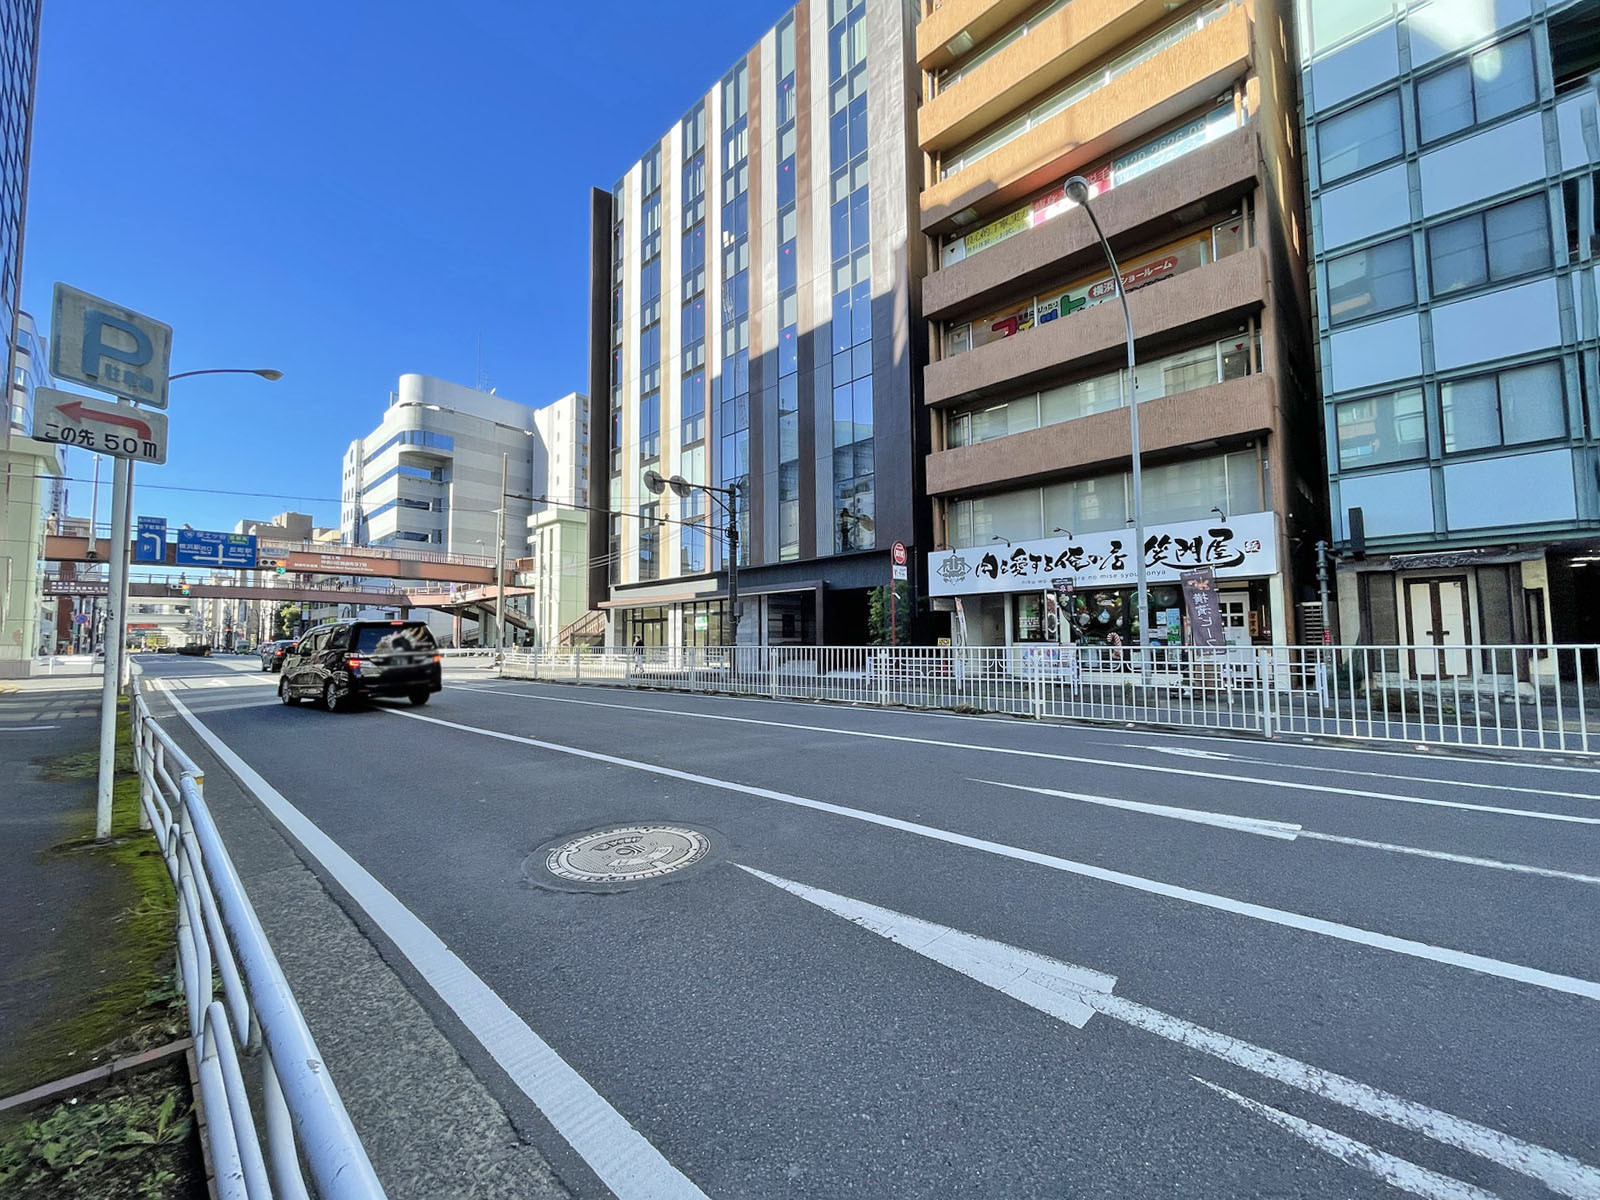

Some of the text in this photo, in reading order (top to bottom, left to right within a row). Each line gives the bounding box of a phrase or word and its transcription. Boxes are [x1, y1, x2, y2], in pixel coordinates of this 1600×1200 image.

[1091, 260, 1173, 296] 横浜ショールーム
[82, 309, 153, 380] P
[975, 528, 1246, 580] 肉を愛する俺の店 笑門屋
[1120, 569, 1166, 579] syouonya
